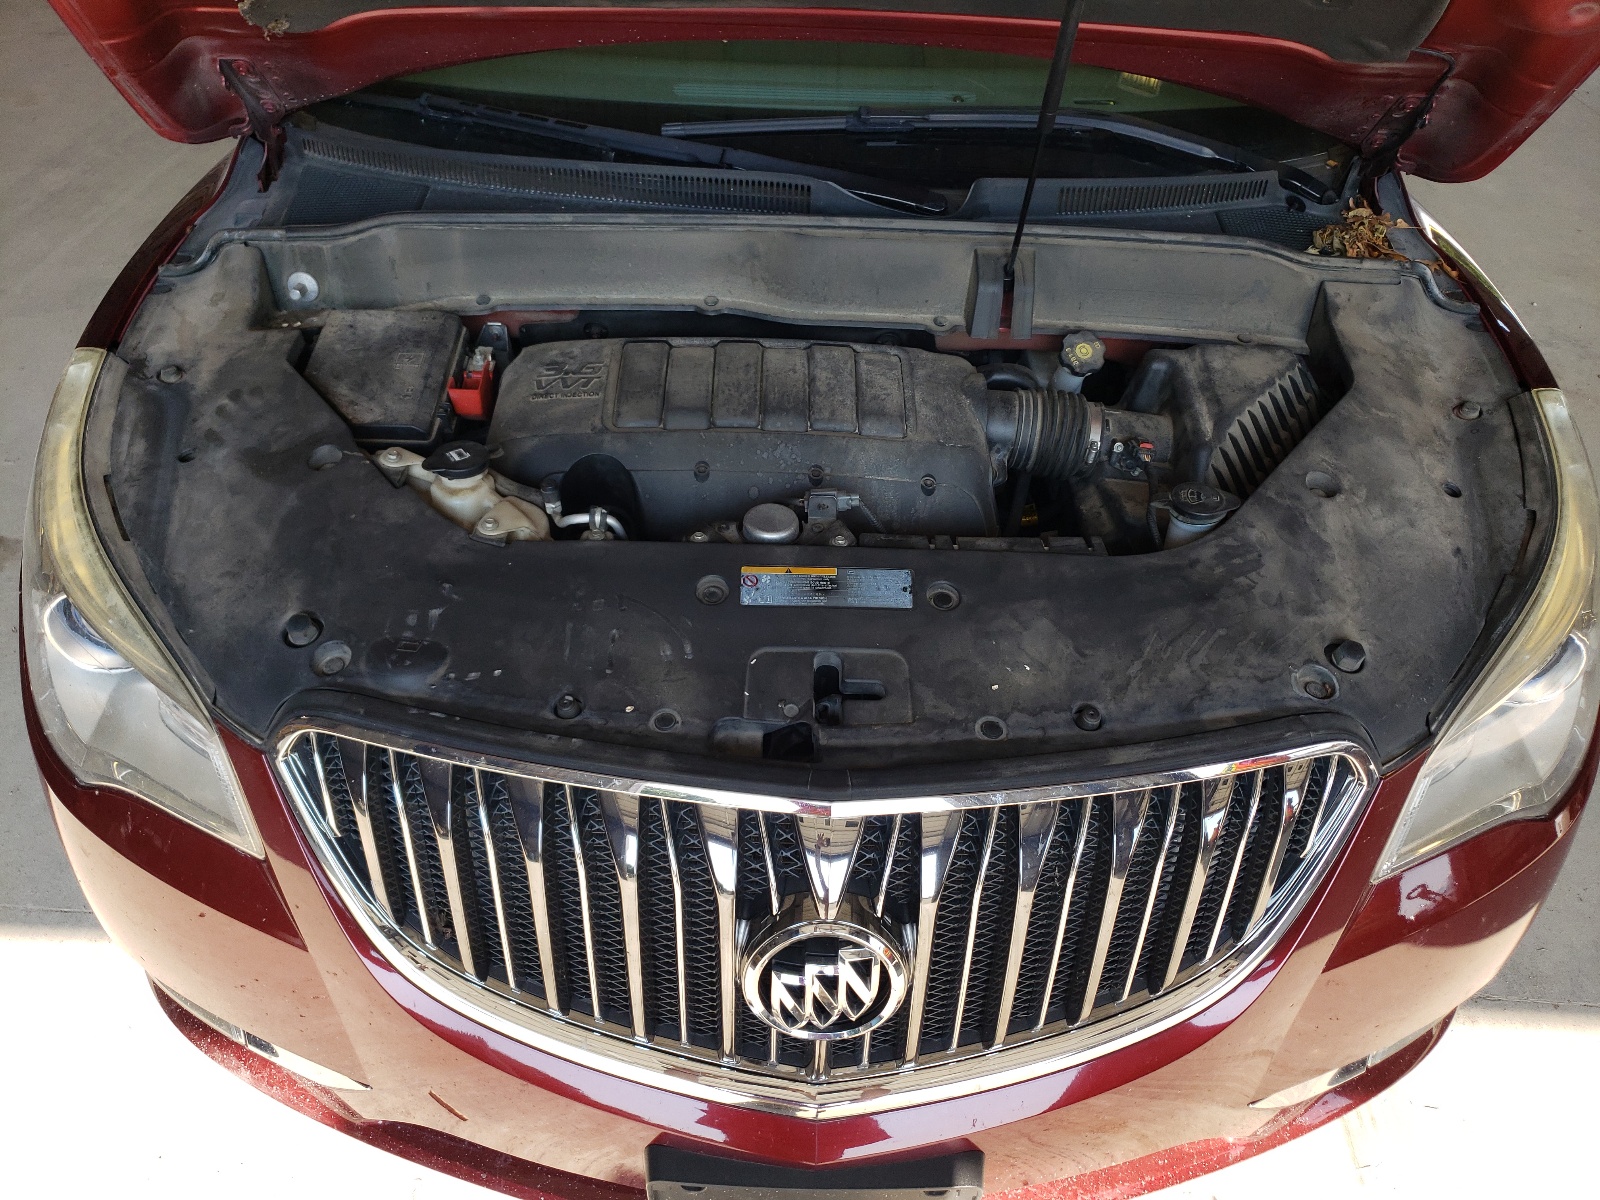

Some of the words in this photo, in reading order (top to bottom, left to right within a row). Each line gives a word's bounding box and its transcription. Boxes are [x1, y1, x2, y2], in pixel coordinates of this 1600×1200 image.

[537, 360, 606, 378] 3.6
[535, 376, 602, 391] VVT
[531, 392, 559, 400] DIRECT
[561, 391, 600, 399] INJECTION
